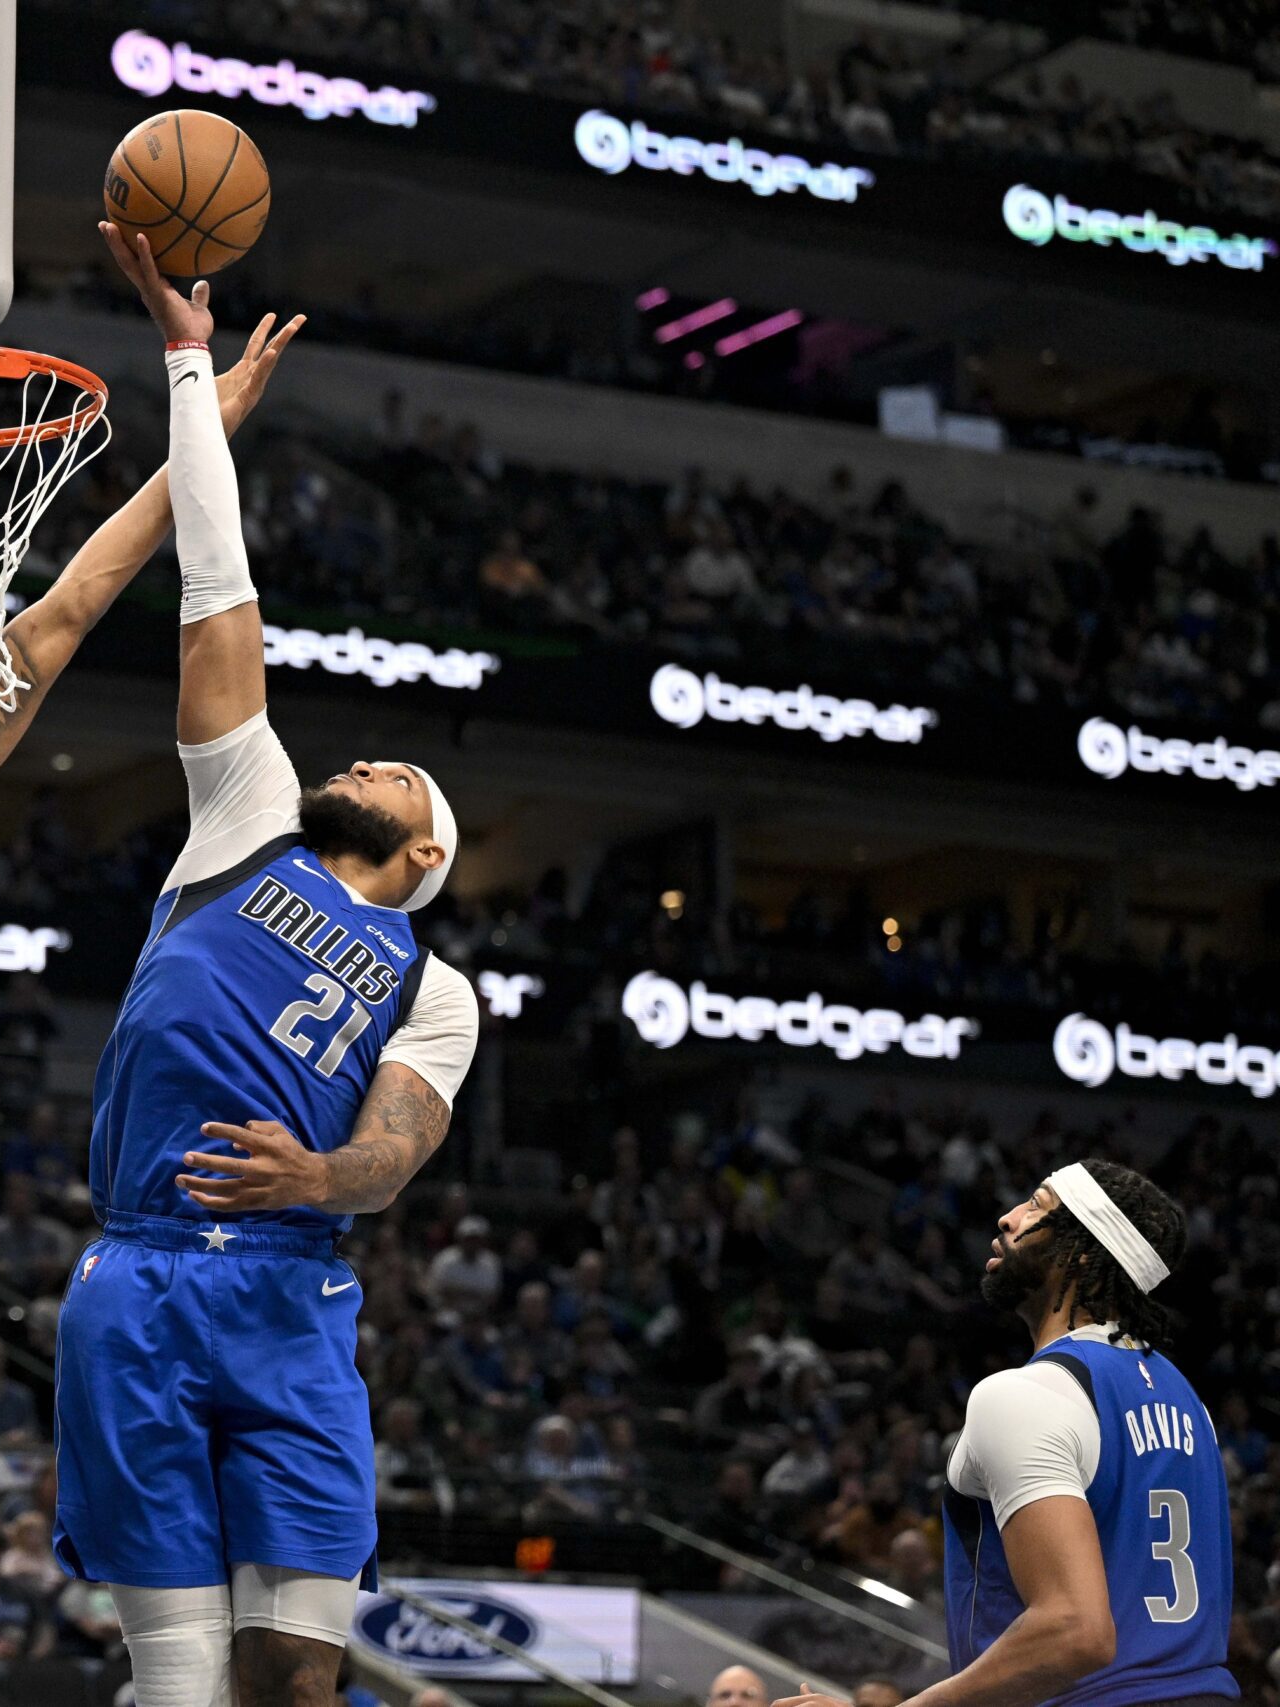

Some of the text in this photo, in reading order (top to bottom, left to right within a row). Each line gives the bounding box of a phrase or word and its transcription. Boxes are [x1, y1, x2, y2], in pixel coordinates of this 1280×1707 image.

[172, 41, 428, 128] bedgear
[631, 120, 869, 203] bedgear
[1054, 193, 1272, 272] bedgear
[704, 672, 930, 744] bedgear
[238, 875, 400, 1005] DALLAS
[365, 924, 410, 960] chime
[269, 973, 372, 1078] 21
[689, 980, 970, 1061] bedgear
[1115, 1022, 1280, 1098] bedg
[1125, 1402, 1194, 1457] DAVIS
[1144, 1489, 1199, 1624] 3
[384, 1599, 507, 1657] Ford
